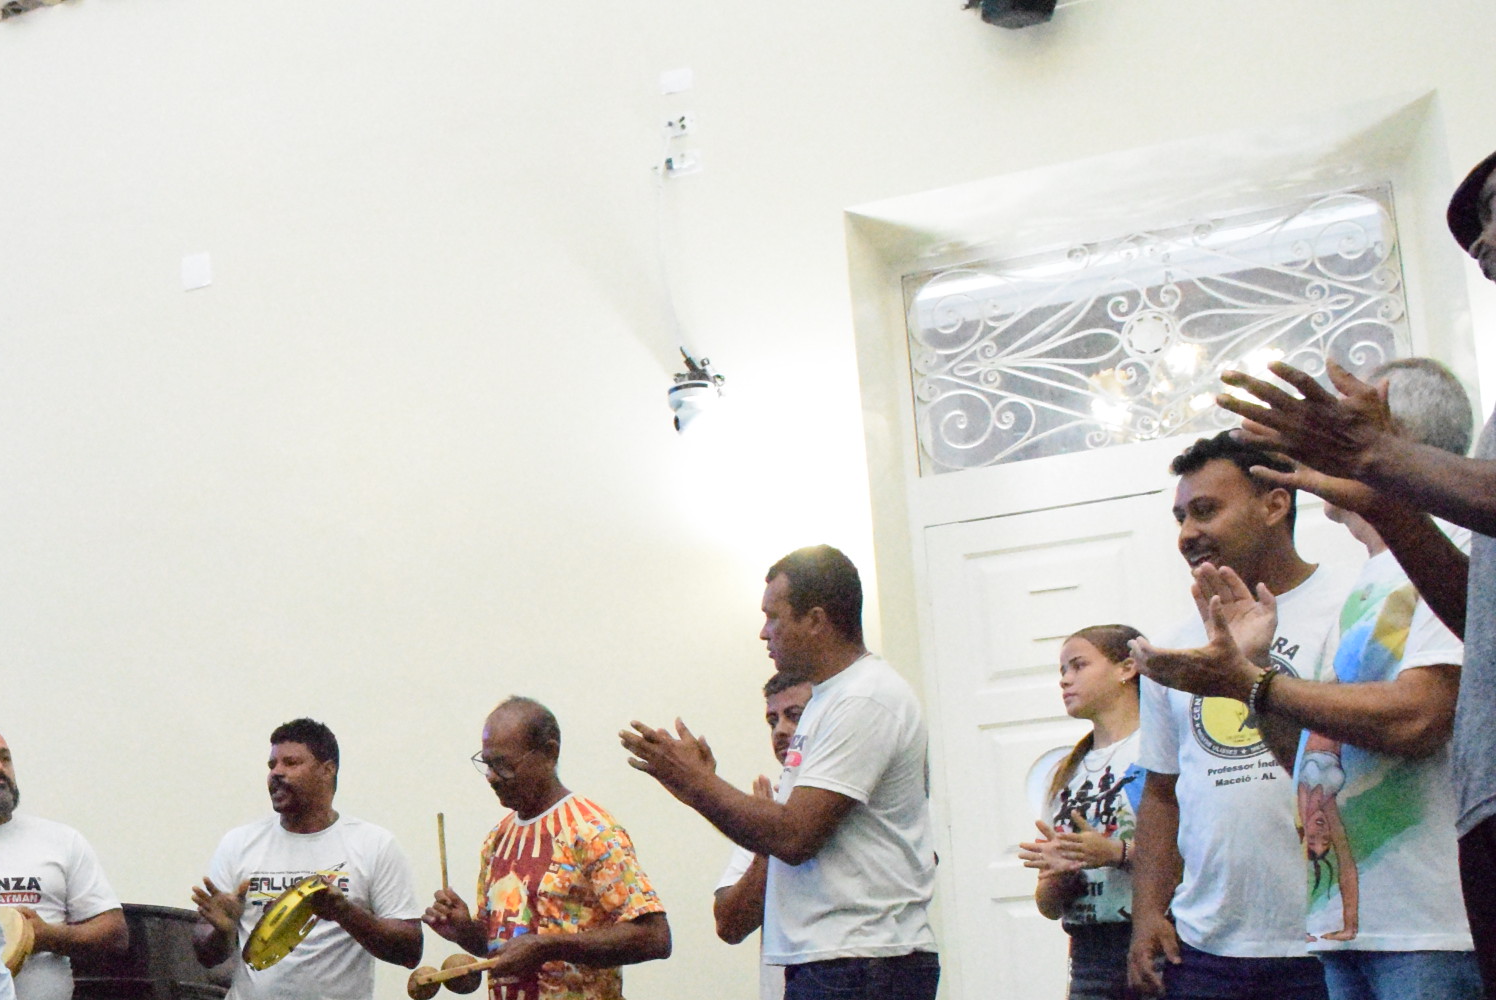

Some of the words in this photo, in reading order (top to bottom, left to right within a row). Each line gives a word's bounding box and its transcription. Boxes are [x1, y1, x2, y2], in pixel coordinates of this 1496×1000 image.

[1207, 763, 1254, 776] Professor
[1215, 775, 1252, 787] Maceió
[1261, 772, 1277, 781] AL
